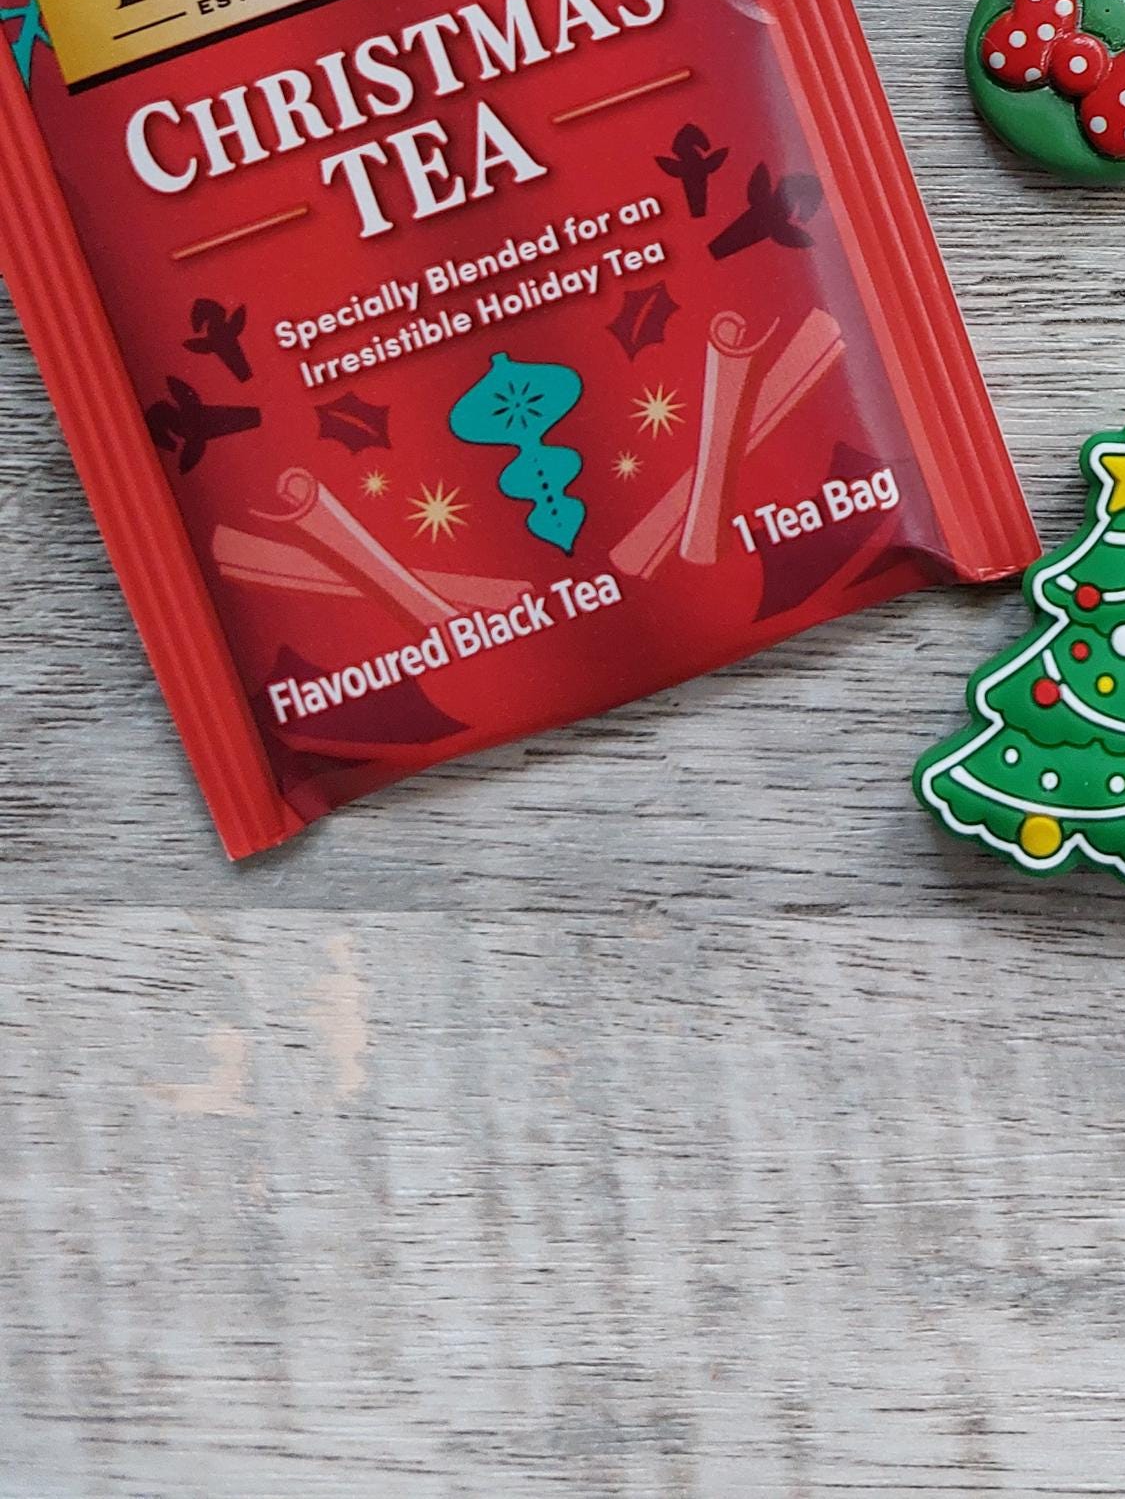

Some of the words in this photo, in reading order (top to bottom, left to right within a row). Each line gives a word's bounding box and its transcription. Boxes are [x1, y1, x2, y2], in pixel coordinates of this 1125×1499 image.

[321, 102, 547, 240] TEA
[274, 281, 420, 349] Specially
[425, 224, 559, 294] Blended
[564, 211, 610, 246] for
[616, 196, 661, 225] an
[299, 308, 473, 388] Irresistible
[478, 264, 601, 326] Holiday
[603, 240, 666, 275] Tea
[733, 514, 755, 553] 1
[752, 497, 824, 542] Tea
[822, 467, 900, 526] Bag
[269, 627, 451, 724] Flavoured
[452, 592, 554, 659] Black
[551, 572, 622, 622] Tea
